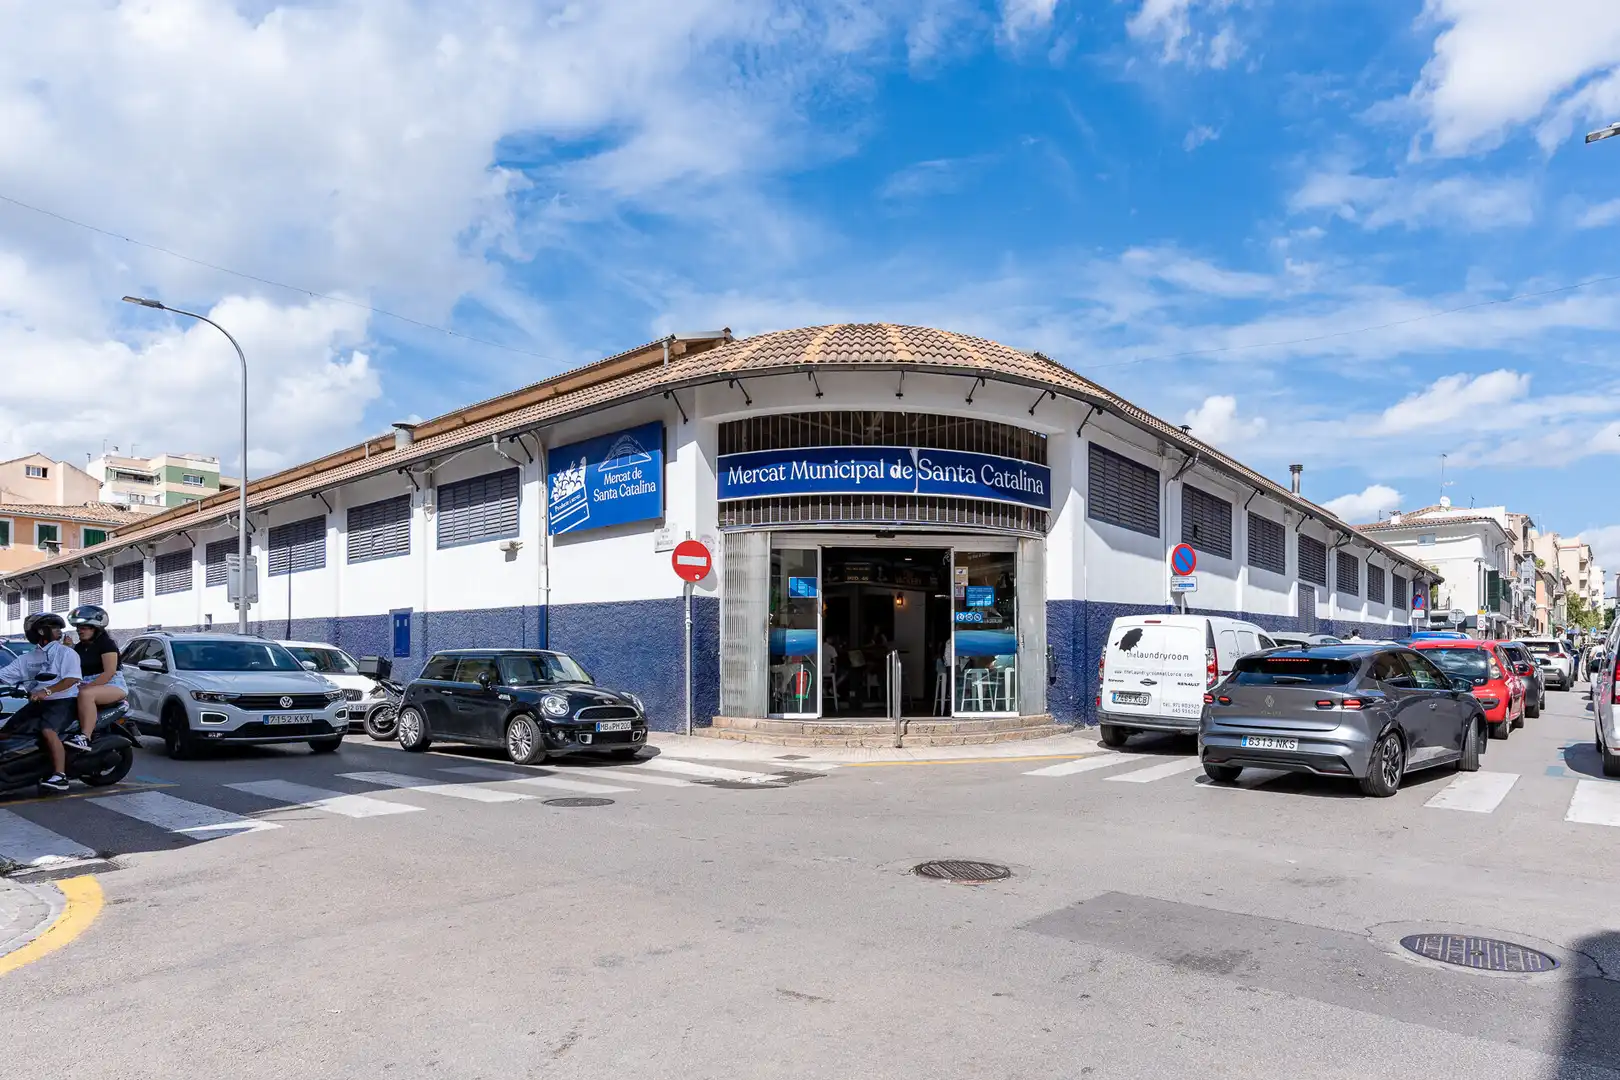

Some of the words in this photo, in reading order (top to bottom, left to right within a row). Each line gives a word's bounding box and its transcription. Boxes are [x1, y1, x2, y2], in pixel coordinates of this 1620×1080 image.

[603, 471, 631, 485] Mercat
[631, 467, 643, 479] de
[728, 464, 787, 486] Mercat
[790, 458, 885, 484] Municipal
[889, 458, 914, 479] de
[918, 458, 977, 484] Santa
[980, 464, 1044, 495] Catalina
[593, 486, 618, 502] Santa
[619, 480, 656, 497] Catalina
[269, 715, 292, 724] 7152
[1248, 736, 1273, 748] 6313
[1275, 738, 1296, 750] NKS
